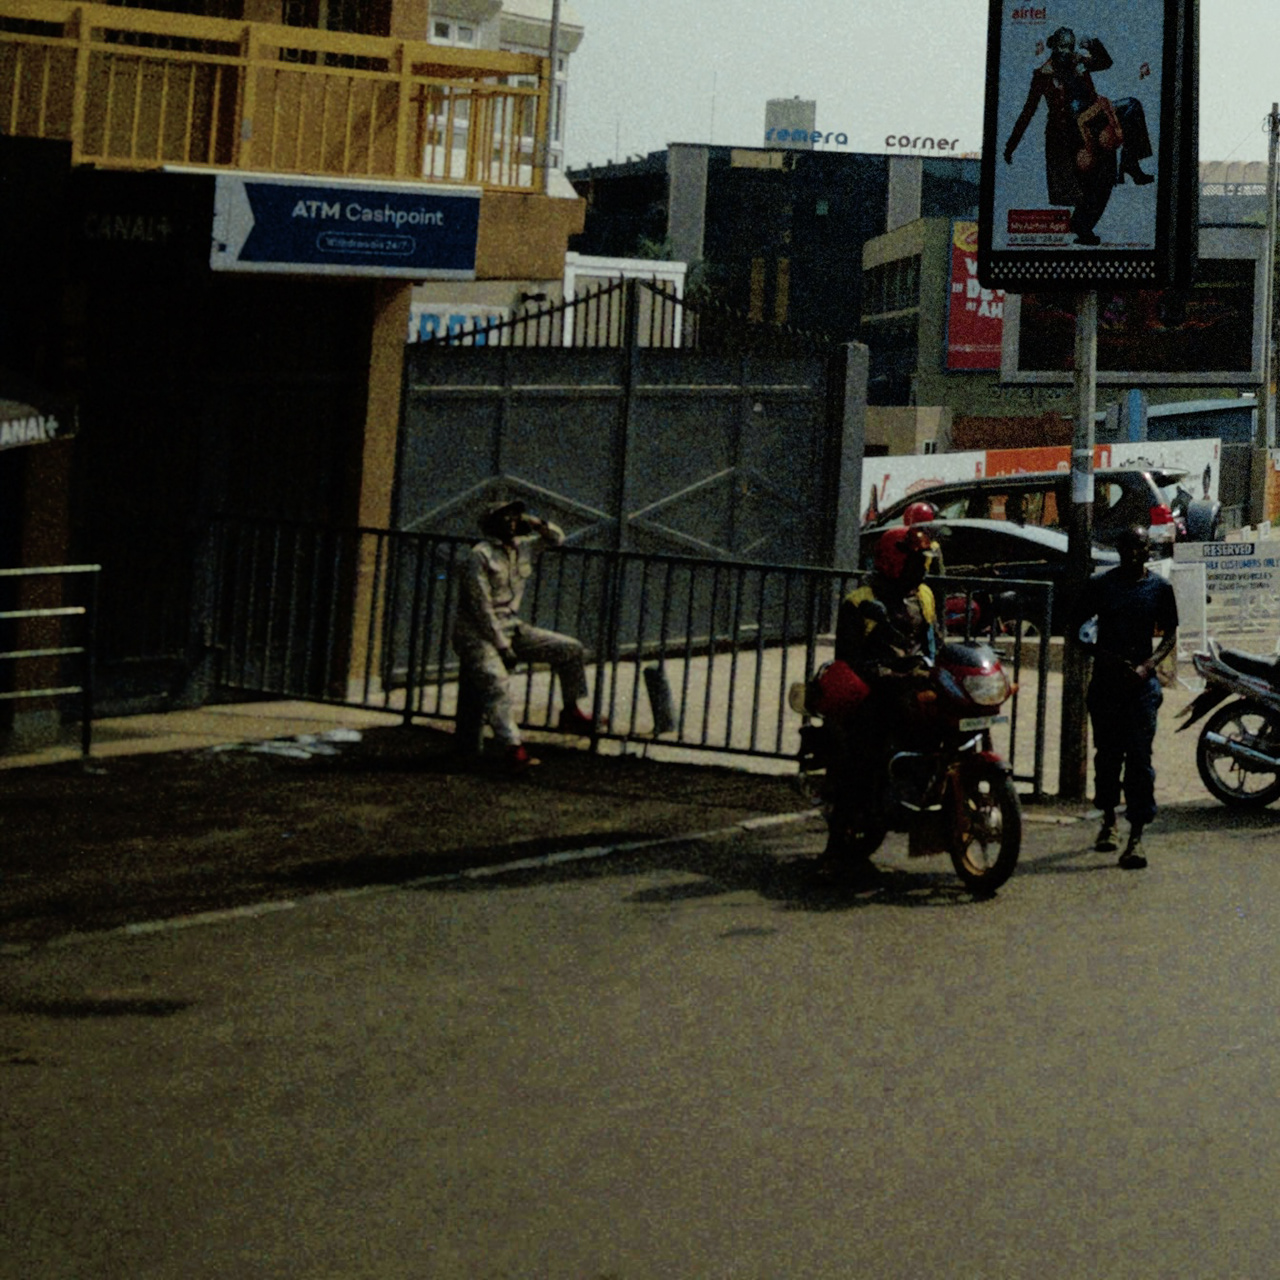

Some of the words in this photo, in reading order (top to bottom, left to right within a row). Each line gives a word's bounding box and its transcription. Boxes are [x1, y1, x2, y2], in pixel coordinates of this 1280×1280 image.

[1012, 7, 1046, 19] airtel
[765, 127, 848, 145] remera
[885, 134, 959, 151] corner
[292, 200, 341, 220] ATM
[345, 202, 444, 229] Cashpoint
[1204, 544, 1252, 556] RESERVED
